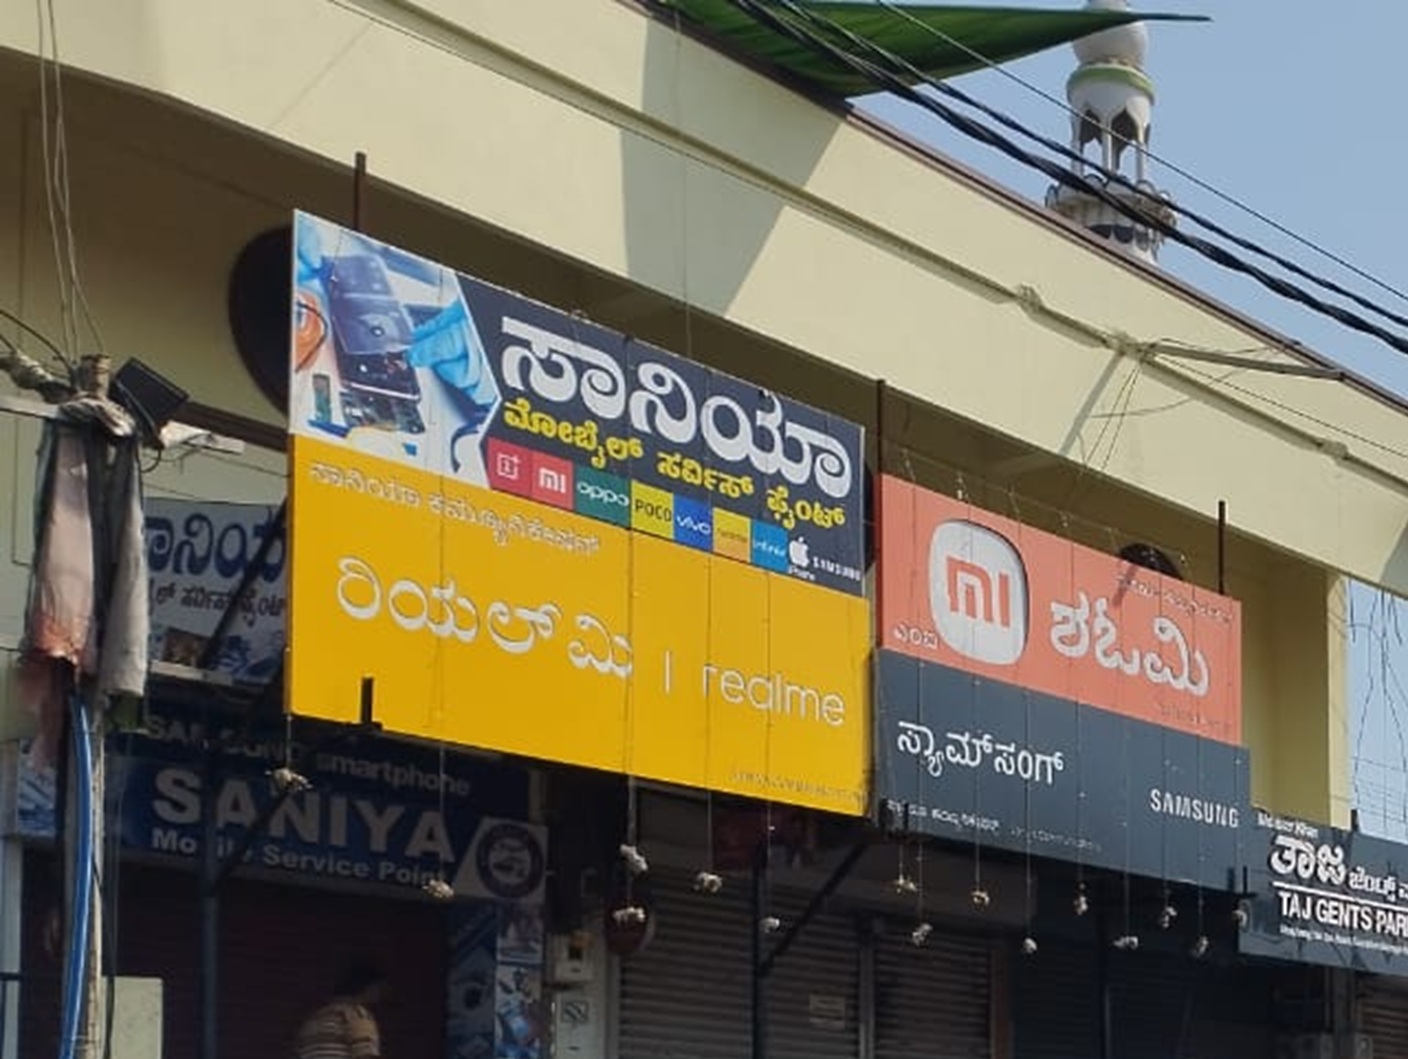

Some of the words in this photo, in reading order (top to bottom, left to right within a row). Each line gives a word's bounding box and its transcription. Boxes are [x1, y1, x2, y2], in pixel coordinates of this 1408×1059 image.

[501, 316, 853, 498] ಸಾನಿಯಾ
[576, 481, 630, 507] oppo
[634, 496, 673, 524] POCO
[676, 516, 712, 535] vivo
[702, 663, 847, 729] realme
[153, 767, 466, 866] SANIYA
[1150, 787, 1241, 829] SAMSUNG
[262, 844, 371, 879] Service
[1278, 890, 1314, 922] TAJ
[1315, 897, 1374, 932] GENTS
